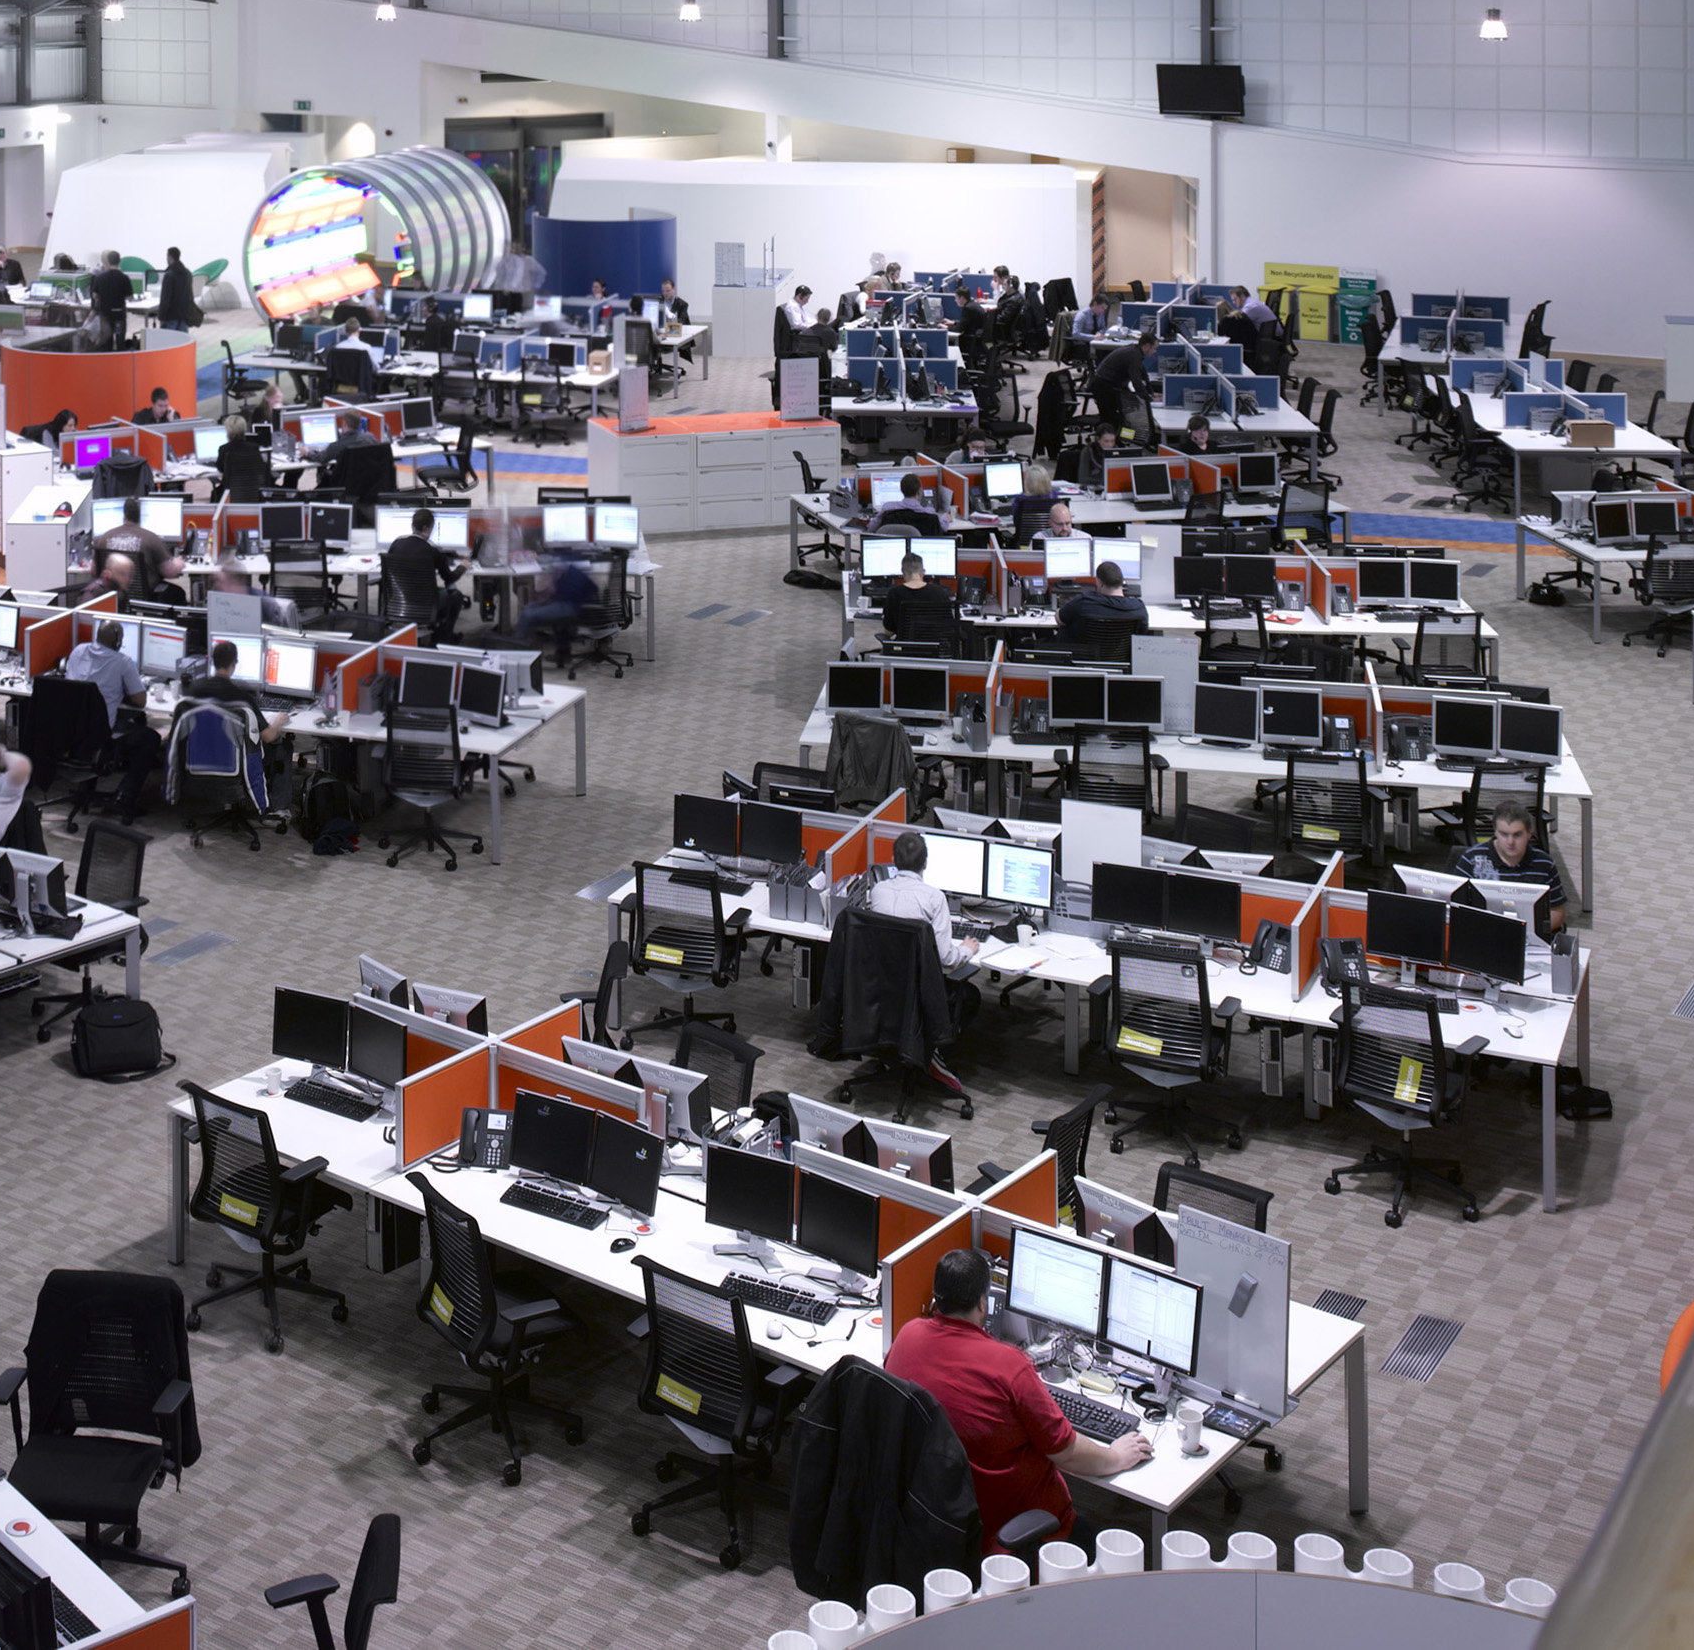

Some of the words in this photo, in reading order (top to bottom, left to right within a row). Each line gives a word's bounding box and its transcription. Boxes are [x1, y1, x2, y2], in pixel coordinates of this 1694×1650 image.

[1284, 271, 1315, 279] Recyclable
[1181, 1211, 1210, 1229] FAULT
[1218, 1223, 1252, 1244] MANAGER
[1258, 1236, 1281, 1254] DESK
[1198, 1230, 1210, 1241] FM
[1219, 1239, 1252, 1256] CHRIS
[1254, 1249, 1262, 1261] G
